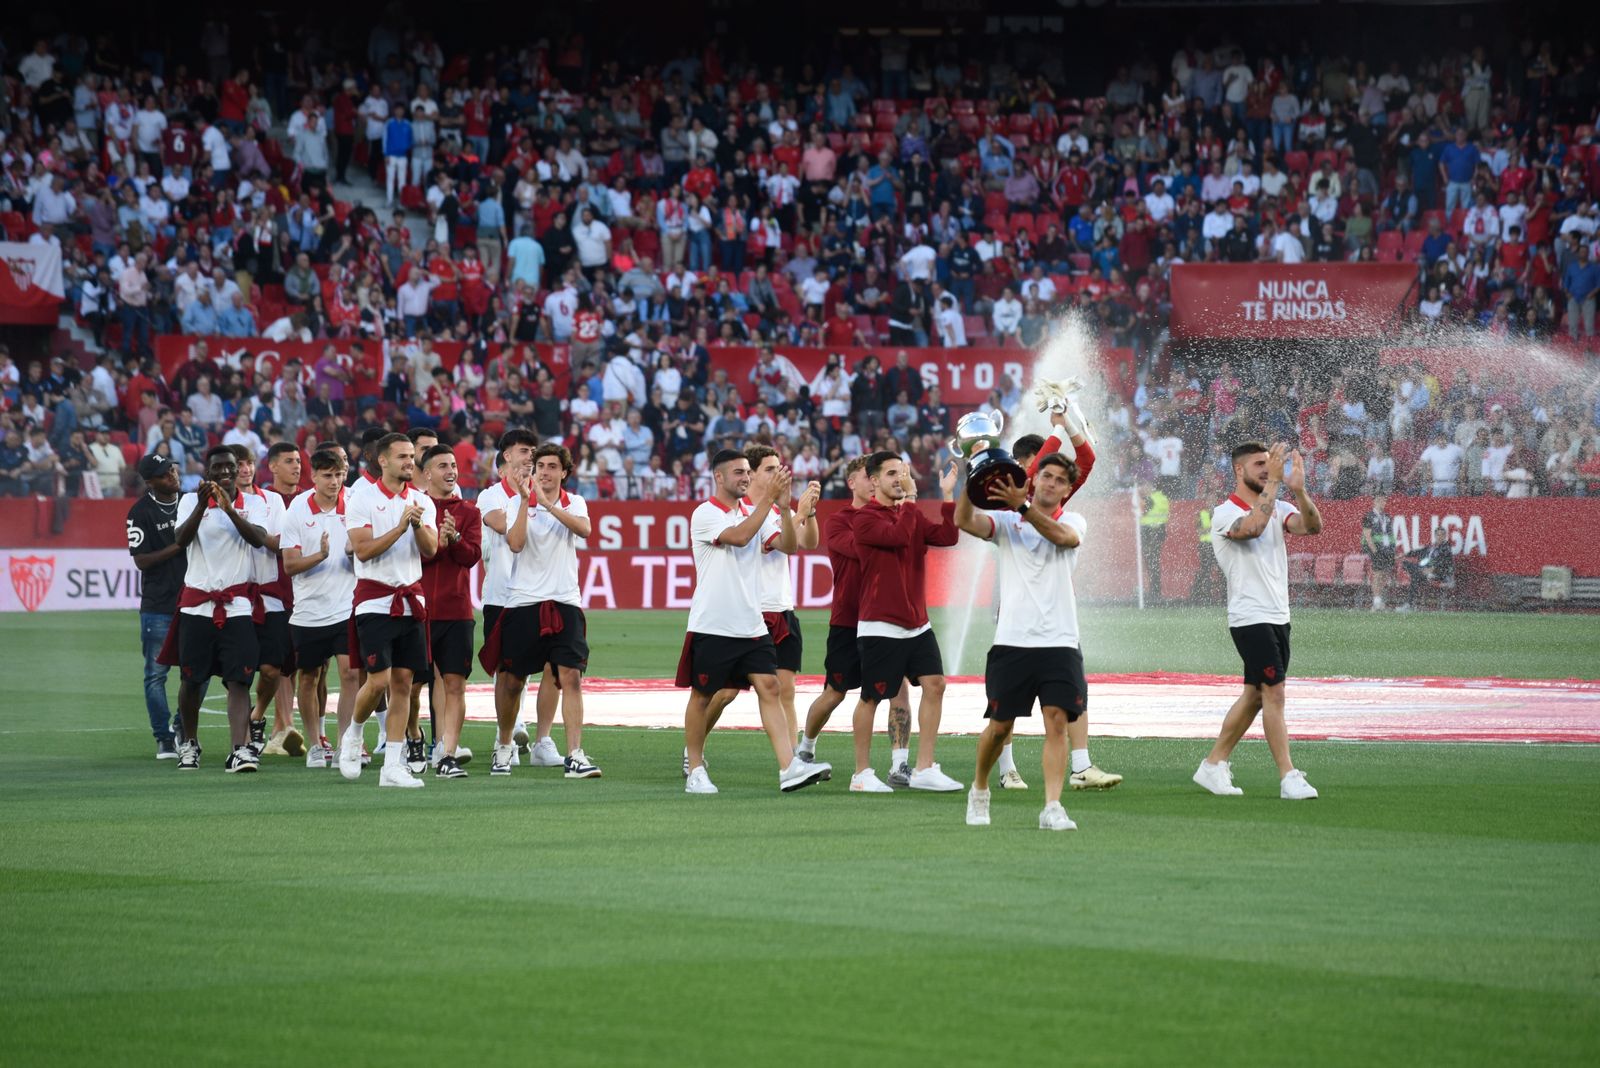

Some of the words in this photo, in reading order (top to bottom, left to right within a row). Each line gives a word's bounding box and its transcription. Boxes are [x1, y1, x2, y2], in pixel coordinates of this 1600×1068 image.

[1259, 280, 1328, 299] NUNCA
[1242, 301, 1266, 320] TE
[1273, 301, 1346, 320] RINDAS
[920, 362, 1023, 389] STOR
[577, 515, 689, 549] STO
[1393, 515, 1487, 556] ALIGA
[67, 569, 142, 598] SEVIL
[630, 556, 694, 608] TE
